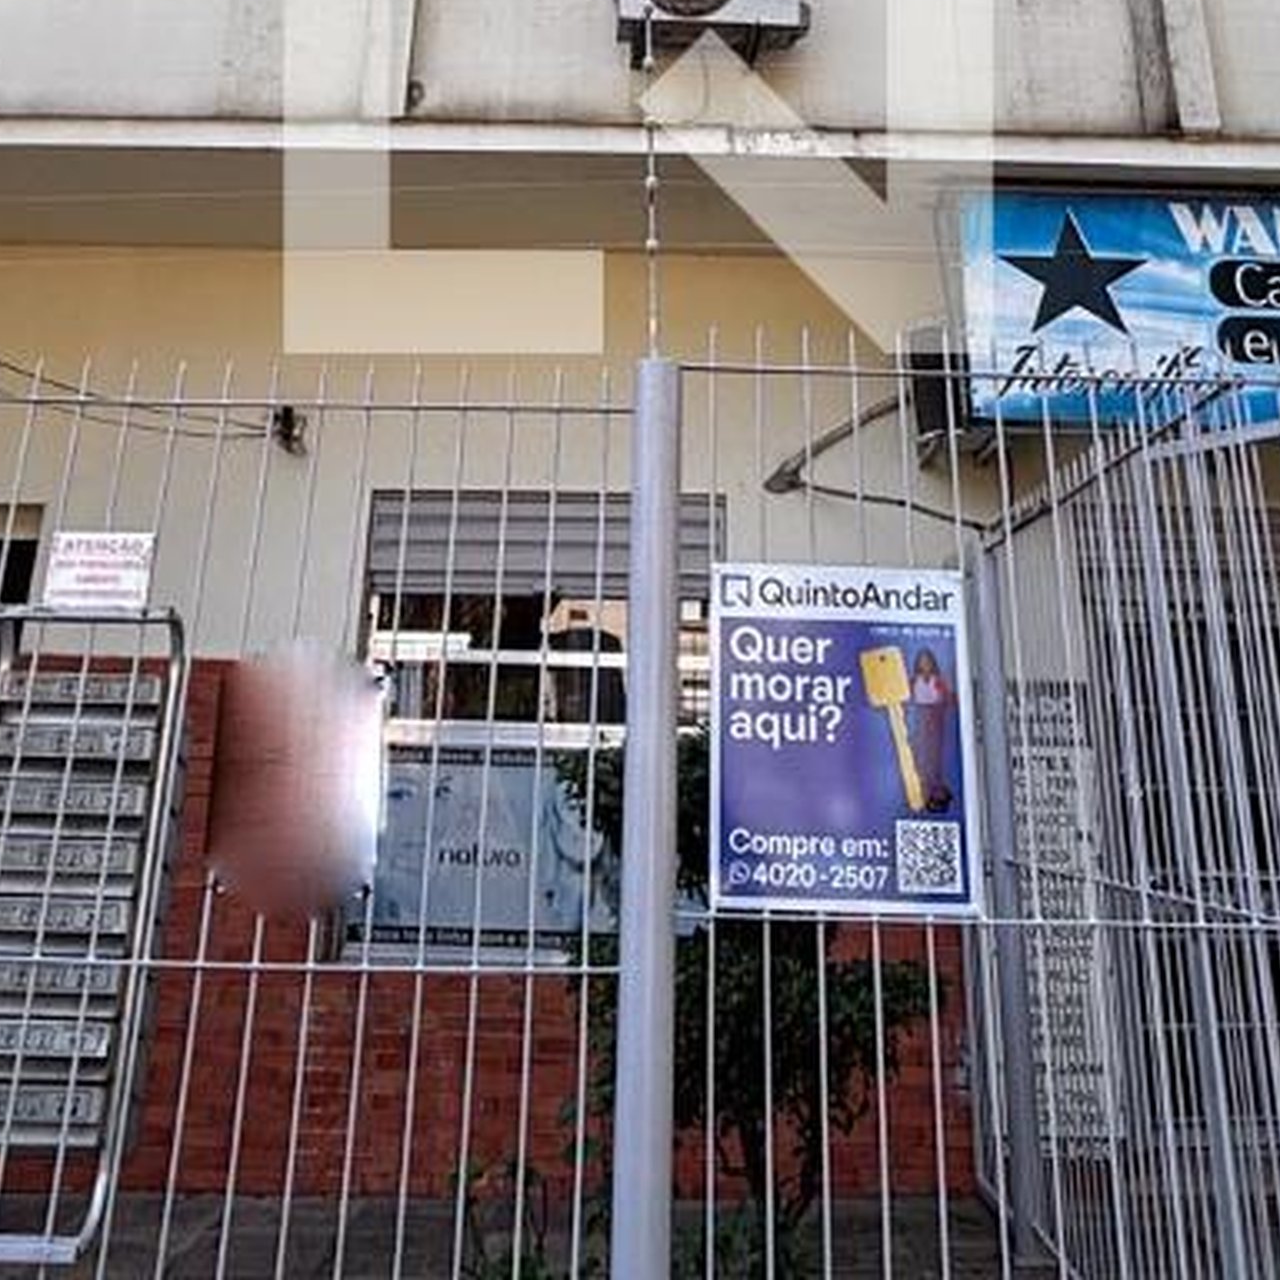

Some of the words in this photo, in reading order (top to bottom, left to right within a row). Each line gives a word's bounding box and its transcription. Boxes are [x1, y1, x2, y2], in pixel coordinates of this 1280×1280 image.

[1242, 327, 1271, 362] e
[758, 576, 956, 613] QuintoAndar
[729, 627, 832, 664] Quer
[729, 671, 852, 704] morar
[729, 703, 843, 750] aqui?
[728, 827, 837, 858] Compre
[841, 836, 890, 859] em:
[752, 862, 890, 890] 4020-2507
